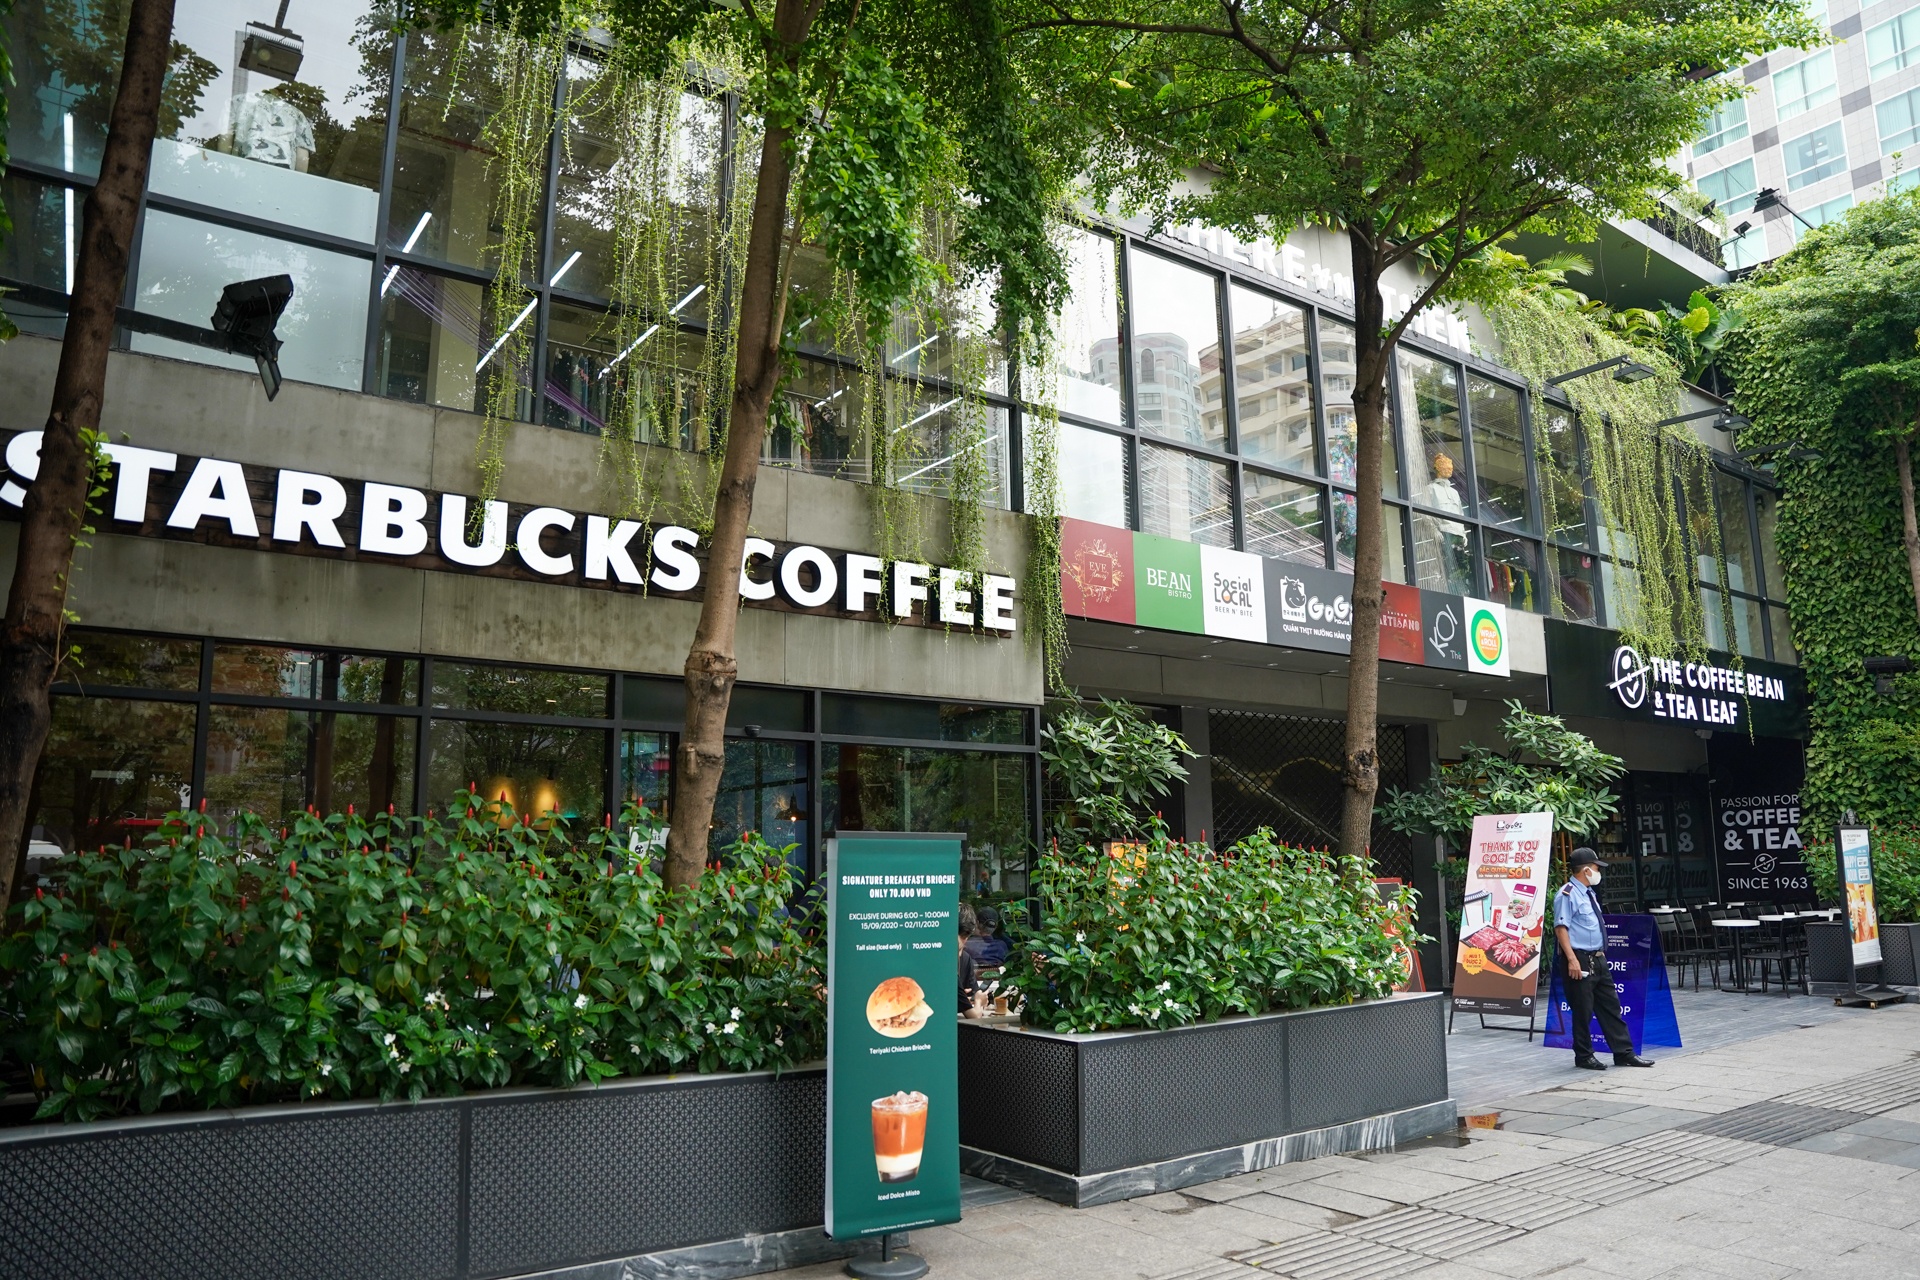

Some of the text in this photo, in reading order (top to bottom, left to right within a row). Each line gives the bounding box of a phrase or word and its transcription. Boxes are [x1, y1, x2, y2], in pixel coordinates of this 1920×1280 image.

[1089, 561, 1107, 573] EVE
[738, 537, 1017, 631] COFFEE
[1146, 567, 1192, 592] BEAN
[1168, 589, 1192, 600] BISTRO
[1240, 609, 1253, 618] BITE
[1429, 603, 1458, 658] KOI
[1480, 629, 1497, 639] WRAP
[1650, 656, 1785, 701] THE COFFEE BEAN
[1654, 694, 1738, 725] & TEA LEAF
[1720, 794, 1799, 809] PASSION FOR
[1721, 807, 1800, 827] COFFEE
[1724, 827, 1803, 851] & TEA
[1480, 840, 1540, 853] THANK YOU
[1482, 852, 1535, 865] GOGI-ERS
[842, 874, 956, 886] SIGNATURE BREAKFAST BRIOCHE
[1728, 876, 1808, 890] SINCE 1963
[869, 887, 931, 899] ONLY 70.000 VND
[849, 912, 880, 921] EXCLUSIVE
[880, 912, 903, 920] DURING
[904, 911, 919, 920] 6:00
[924, 911, 950, 919] 10:00AM
[861, 921, 898, 931] 15/09/2020
[904, 921, 940, 930] 02/11/2020
[889, 943, 902, 951] only)
[912, 942, 931, 950] 70,000
[1607, 961, 1627, 972] ORE
[869, 1043, 931, 1055] Teriyaki Chicken Brioche
[877, 1189, 921, 1201] Iced Dolce Misto
